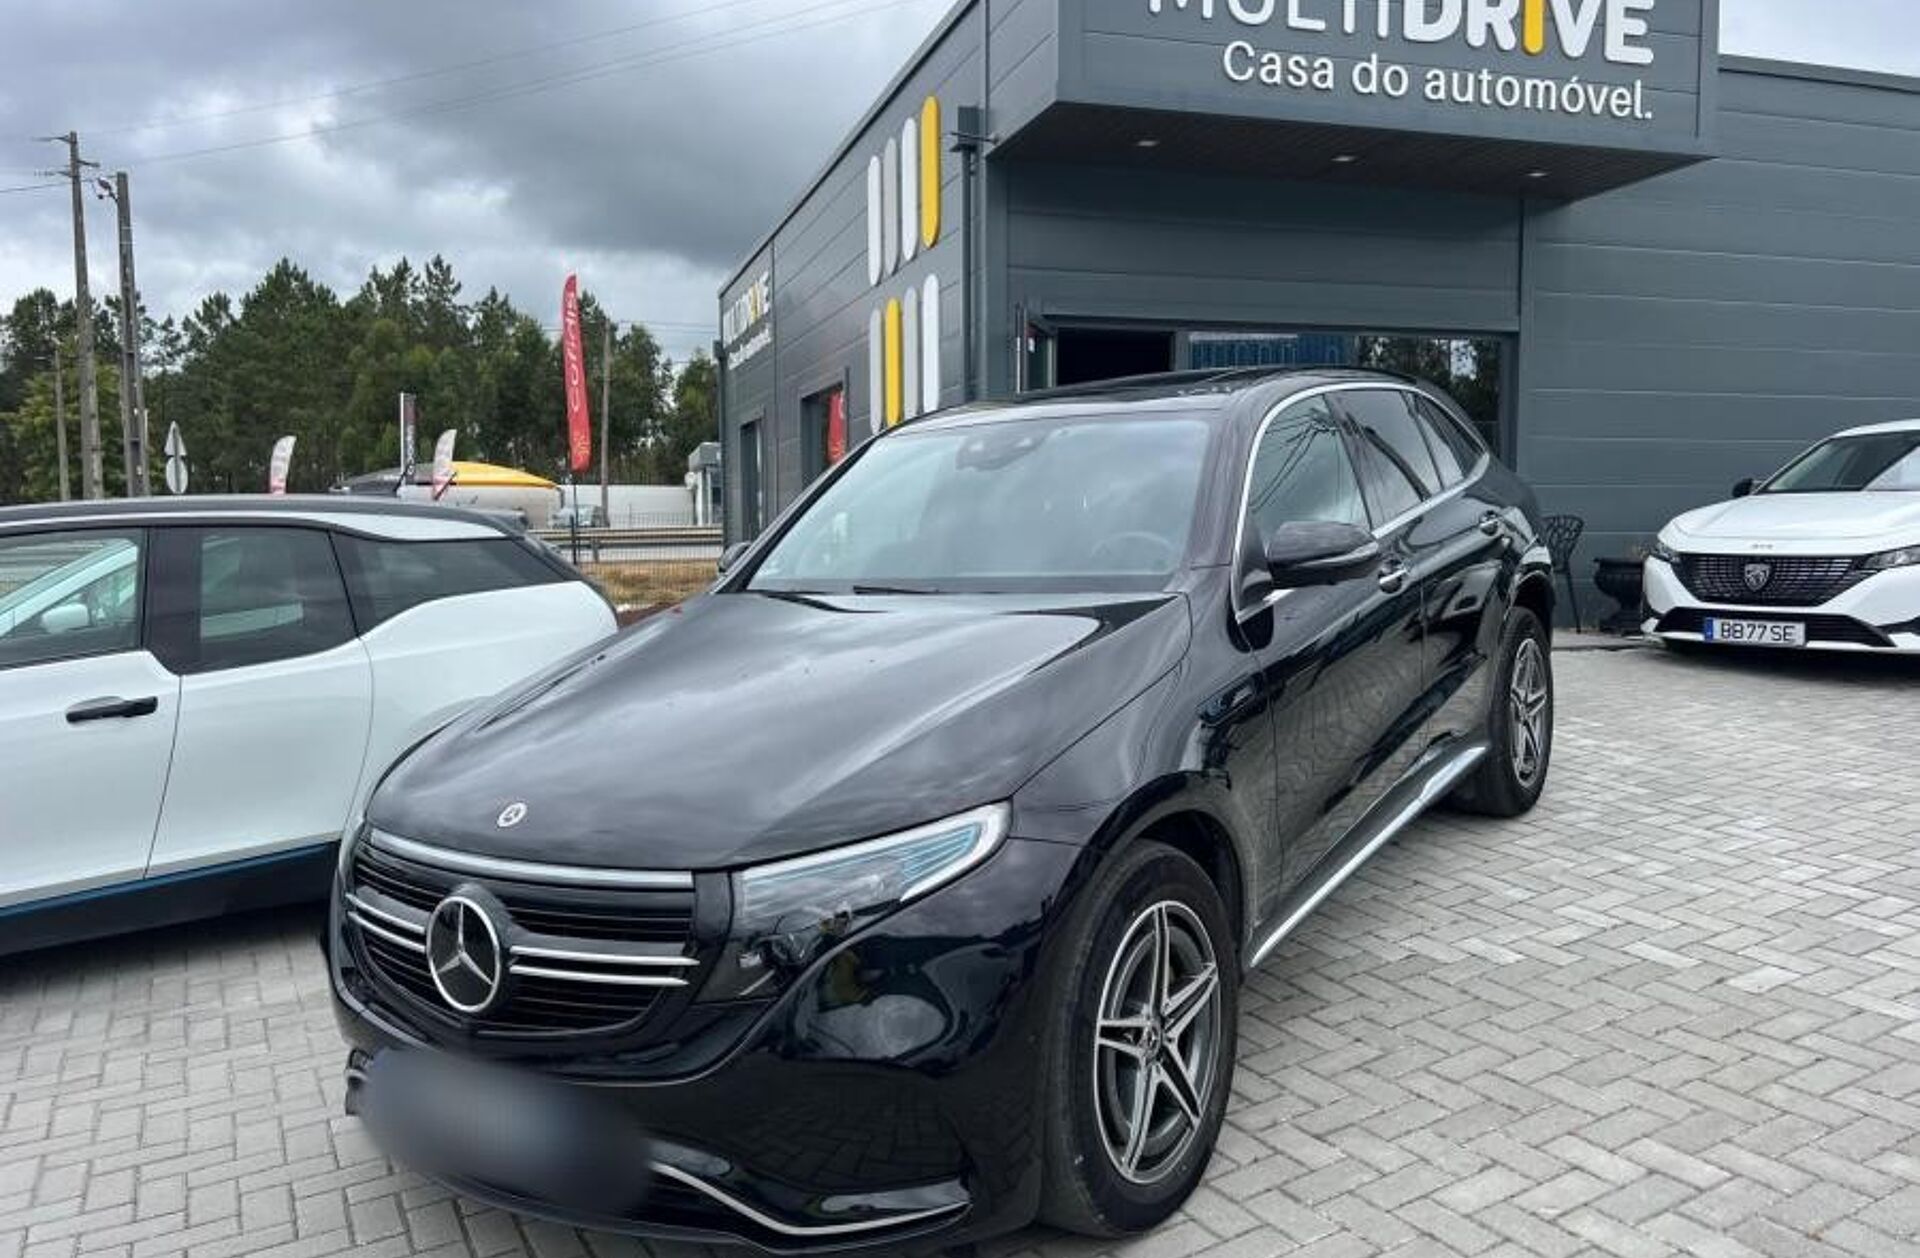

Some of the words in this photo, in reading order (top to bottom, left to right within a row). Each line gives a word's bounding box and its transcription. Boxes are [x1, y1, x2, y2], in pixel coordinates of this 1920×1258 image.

[1149, 0, 1654, 64] IDRIVE
[1223, 41, 1334, 90] Casa
[1352, 53, 1409, 97] do
[1424, 68, 1652, 119] automóvel.
